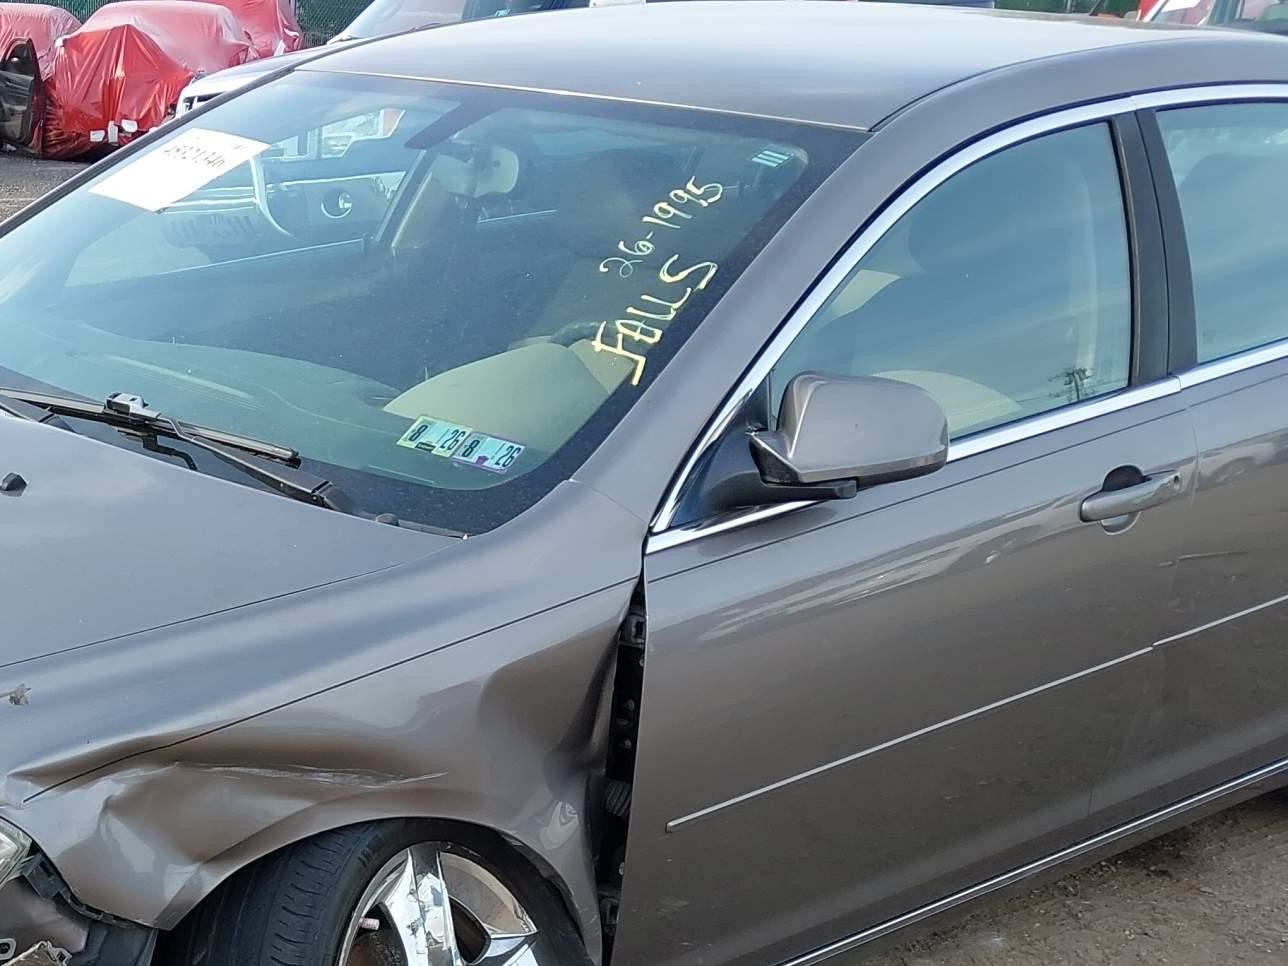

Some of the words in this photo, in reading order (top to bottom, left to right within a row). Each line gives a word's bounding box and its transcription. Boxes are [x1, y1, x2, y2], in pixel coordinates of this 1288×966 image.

[598, 175, 724, 279] 26-1995
[591, 254, 719, 386] FALLS
[409, 424, 428, 441] 8
[440, 429, 466, 450] 26
[462, 440, 480, 457] 8
[495, 446, 521, 467] 26
